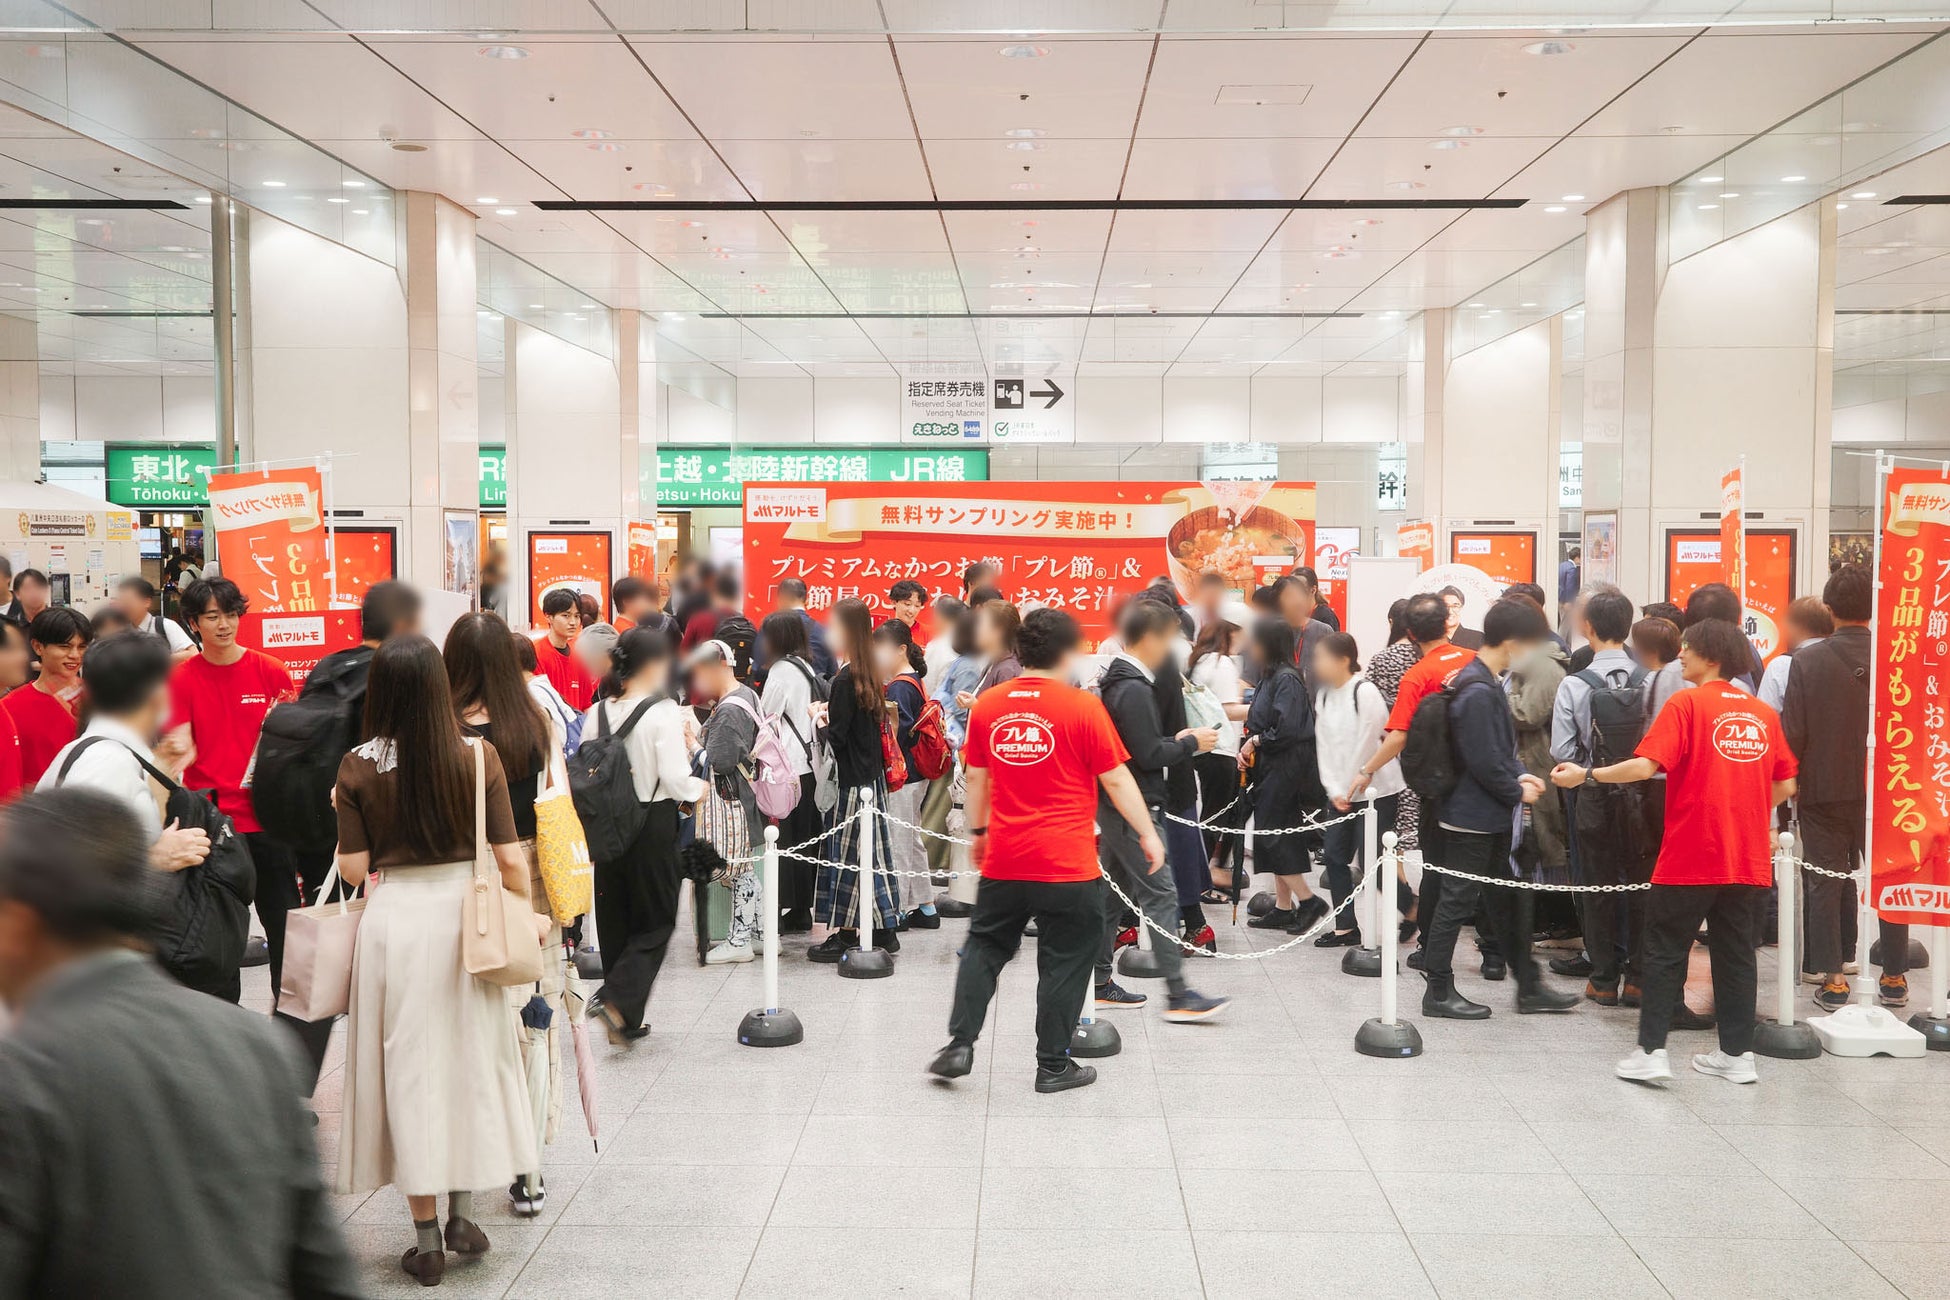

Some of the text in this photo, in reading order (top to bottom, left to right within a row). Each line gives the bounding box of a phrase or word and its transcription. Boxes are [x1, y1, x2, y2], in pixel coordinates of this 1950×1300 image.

[908, 381, 985, 397] 指定席券売機
[911, 400, 985, 408] Reserved Seat Ticket
[926, 409, 985, 418] Vending Machine
[913, 422, 959, 436] えきねっと
[478, 455, 506, 481] R
[890, 456, 965, 481] JR線
[1379, 471, 1406, 498] 幹
[772, 505, 819, 517] マルトモ
[881, 504, 1133, 530] 無料サンプリング実施中！
[1744, 597, 1777, 614] といえば
[283, 631, 319, 642] マルトモ
[284, 658, 321, 668] クロンソフ
[995, 743, 1048, 753] PREMIUM
